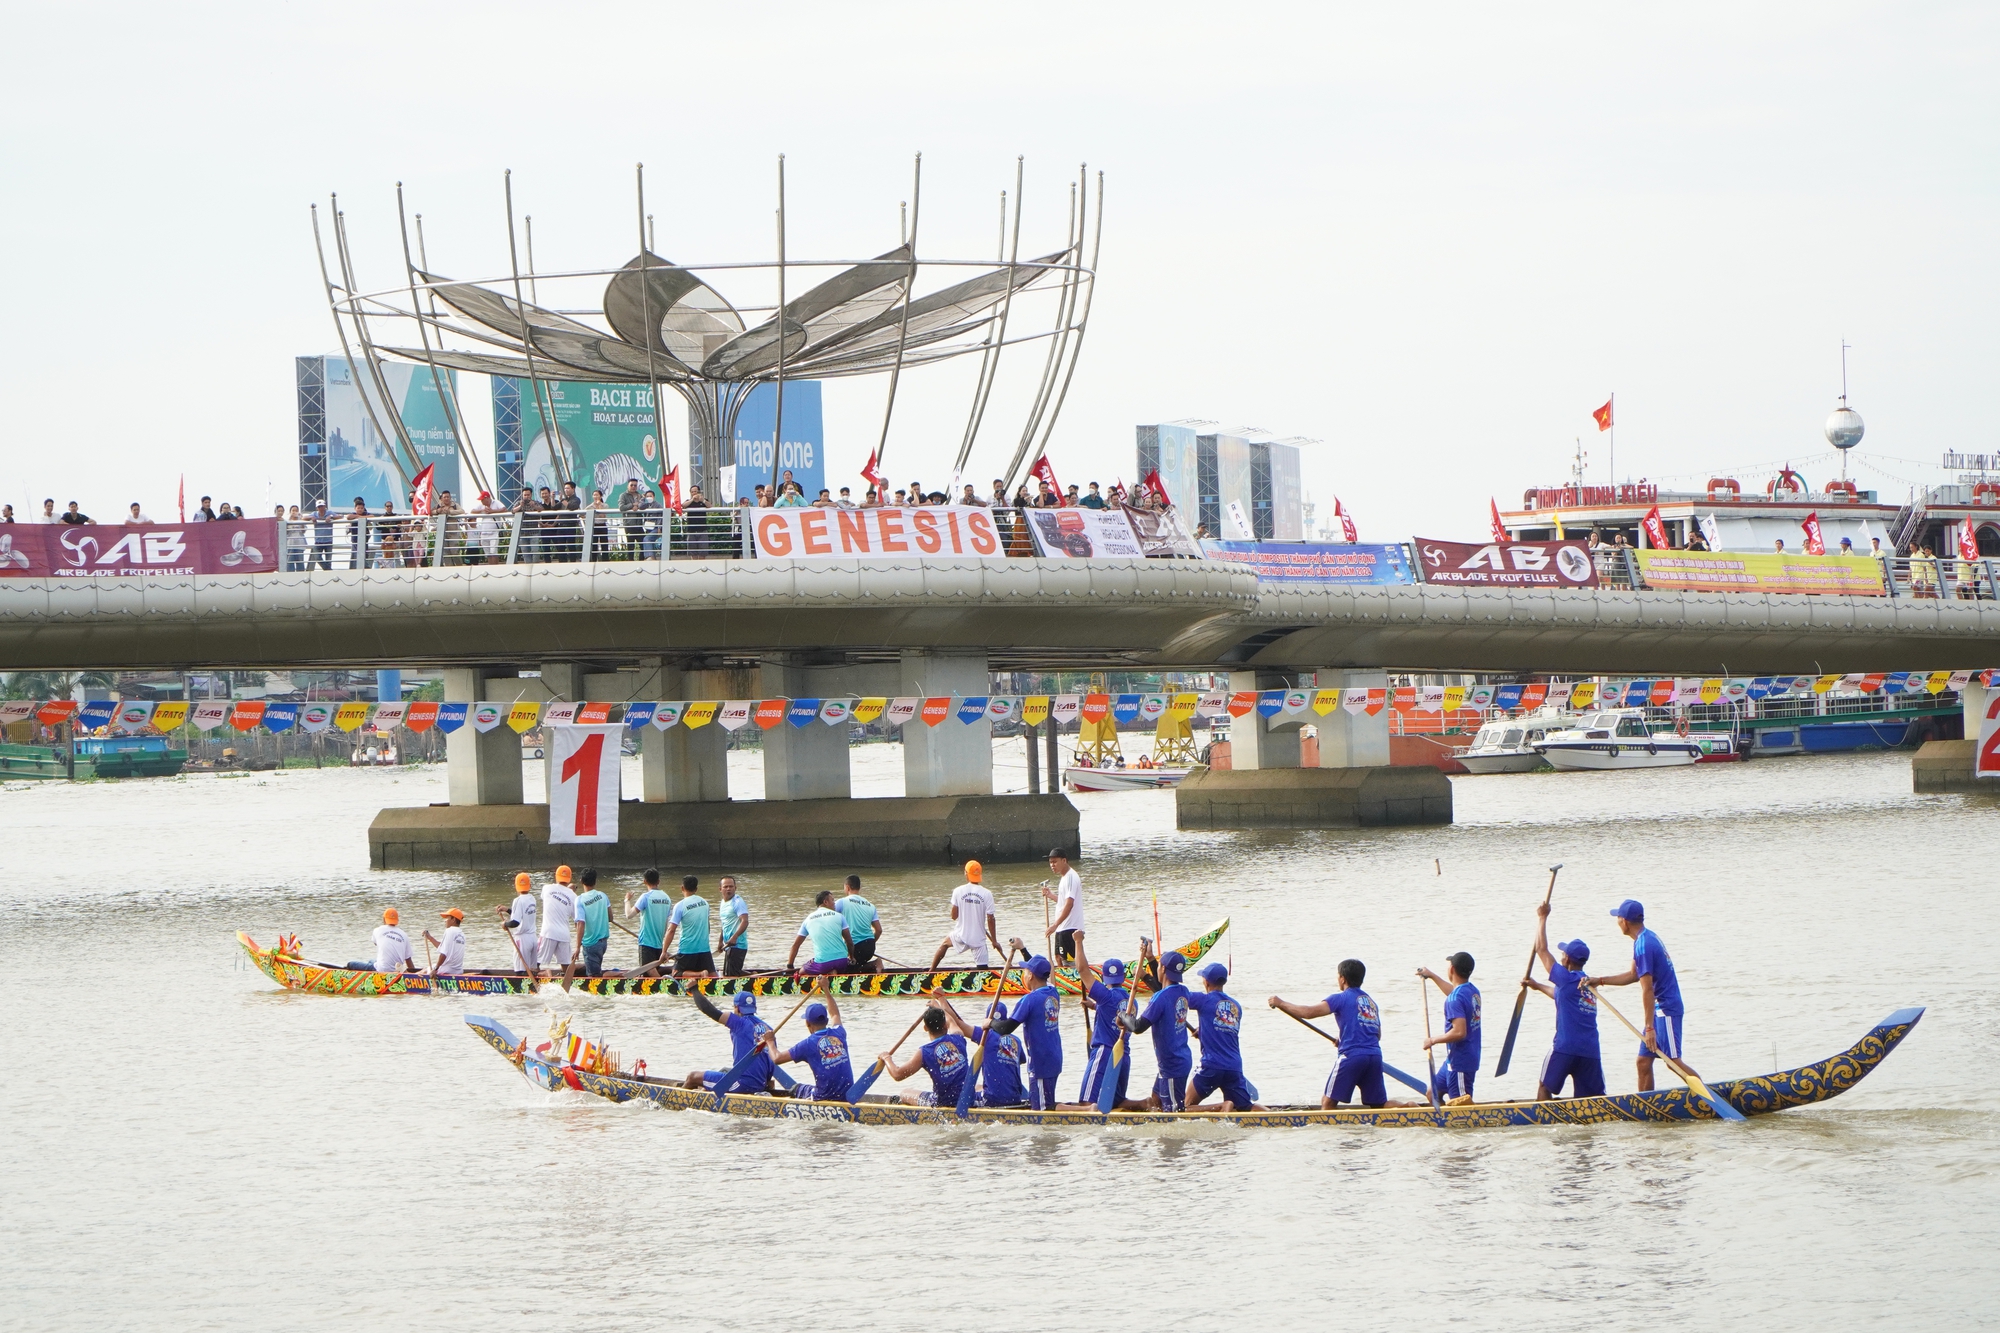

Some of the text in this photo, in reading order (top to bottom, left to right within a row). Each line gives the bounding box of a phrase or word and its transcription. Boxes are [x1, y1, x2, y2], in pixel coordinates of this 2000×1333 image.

[590, 388, 632, 410] BẠCH
[593, 412, 654, 425] HOẠT LẠC CAO
[406, 426, 455, 441] Chung niềm tin
[446, 444, 455, 455] lai
[1581, 486, 1616, 506] NINH
[1231, 504, 1250, 536] RATO
[758, 510, 996, 556] GENESIS
[95, 532, 186, 564] AB
[1458, 546, 1550, 570] AB
[54, 567, 194, 577] AIRBLADE PROPELLER
[1431, 572, 1558, 582] AIRBLADE PROPELLER
[1395, 694, 1414, 702] GENESIS
[1498, 692, 1519, 700] HYUNDAI
[1524, 692, 1544, 700] GENESIS
[1580, 690, 1594, 698] RATO
[862, 704, 882, 712] RATO
[1084, 703, 1107, 712] GENESIS
[1116, 703, 1138, 712] HYUNDAI
[1258, 700, 1282, 708] HYUNDAI
[41, 707, 71, 716] GENESIS
[81, 708, 112, 718] HYUNDAI
[756, 709, 782, 718] GENESIS
[790, 708, 816, 716] HYUNDAI
[923, 706, 946, 715] GENESIS
[960, 706, 984, 714] HYUNDAI
[1029, 705, 1046, 713] RATO
[162, 710, 184, 720] RATO
[233, 711, 260, 720] GENESIS
[266, 710, 294, 720] HYUNDAI
[344, 711, 364, 720] RATO
[408, 712, 435, 720] GENESIS
[439, 712, 465, 721] HYUNDAI
[516, 712, 536, 720] RATO
[580, 712, 606, 720] GENESIS
[626, 711, 652, 720] HYUNDAI
[691, 710, 712, 718] RATO
[562, 734, 605, 836] 1
[405, 974, 429, 989] CHÙA
[458, 978, 484, 992] RĂNG
[484, 978, 502, 991] SÂY
